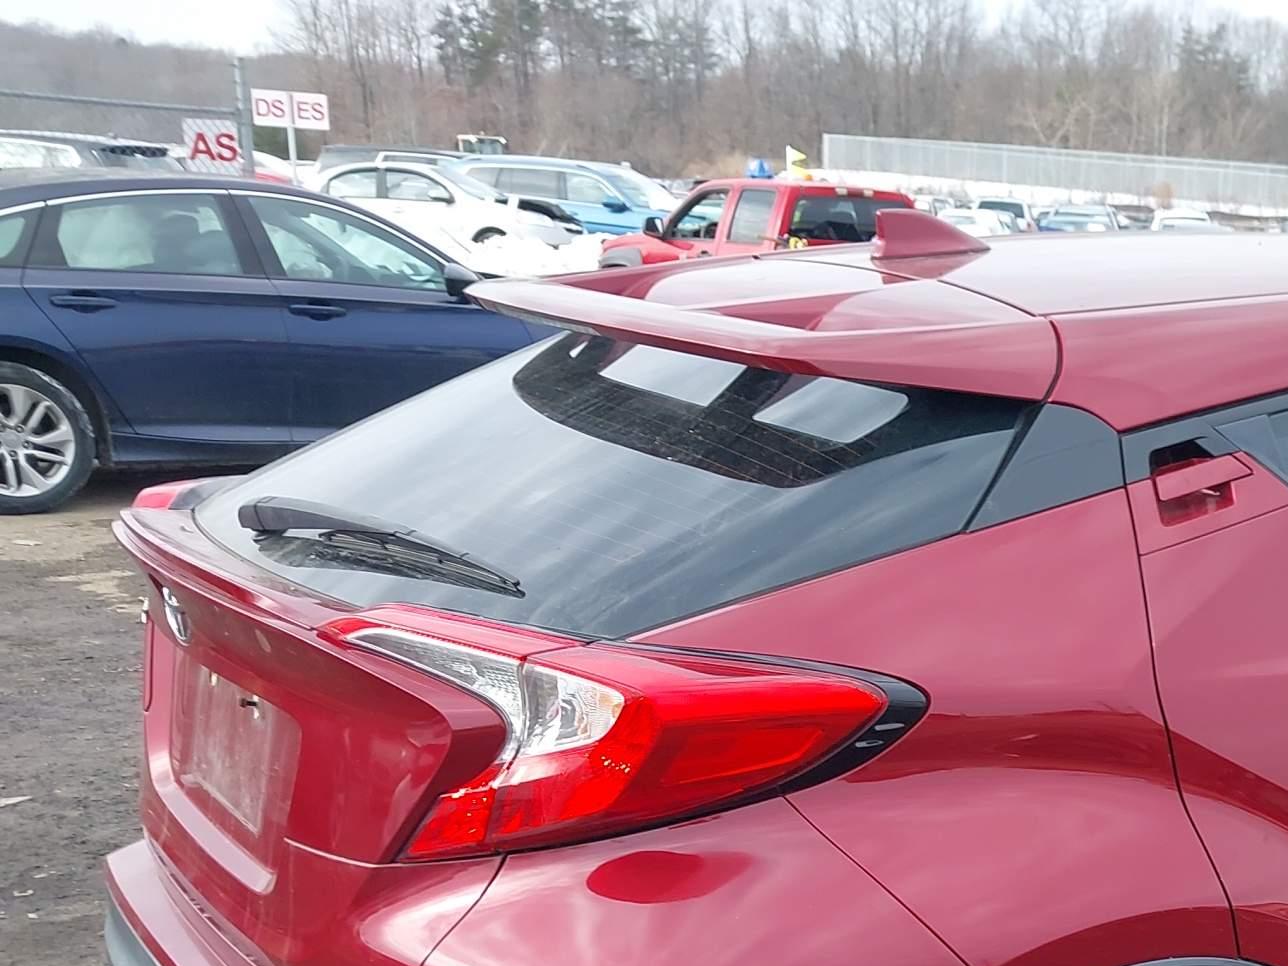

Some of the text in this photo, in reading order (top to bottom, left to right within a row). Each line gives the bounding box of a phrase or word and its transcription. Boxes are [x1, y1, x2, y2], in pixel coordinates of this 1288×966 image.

[255, 98, 286, 118] DS
[297, 101, 325, 121] ES
[190, 132, 238, 161] AS
